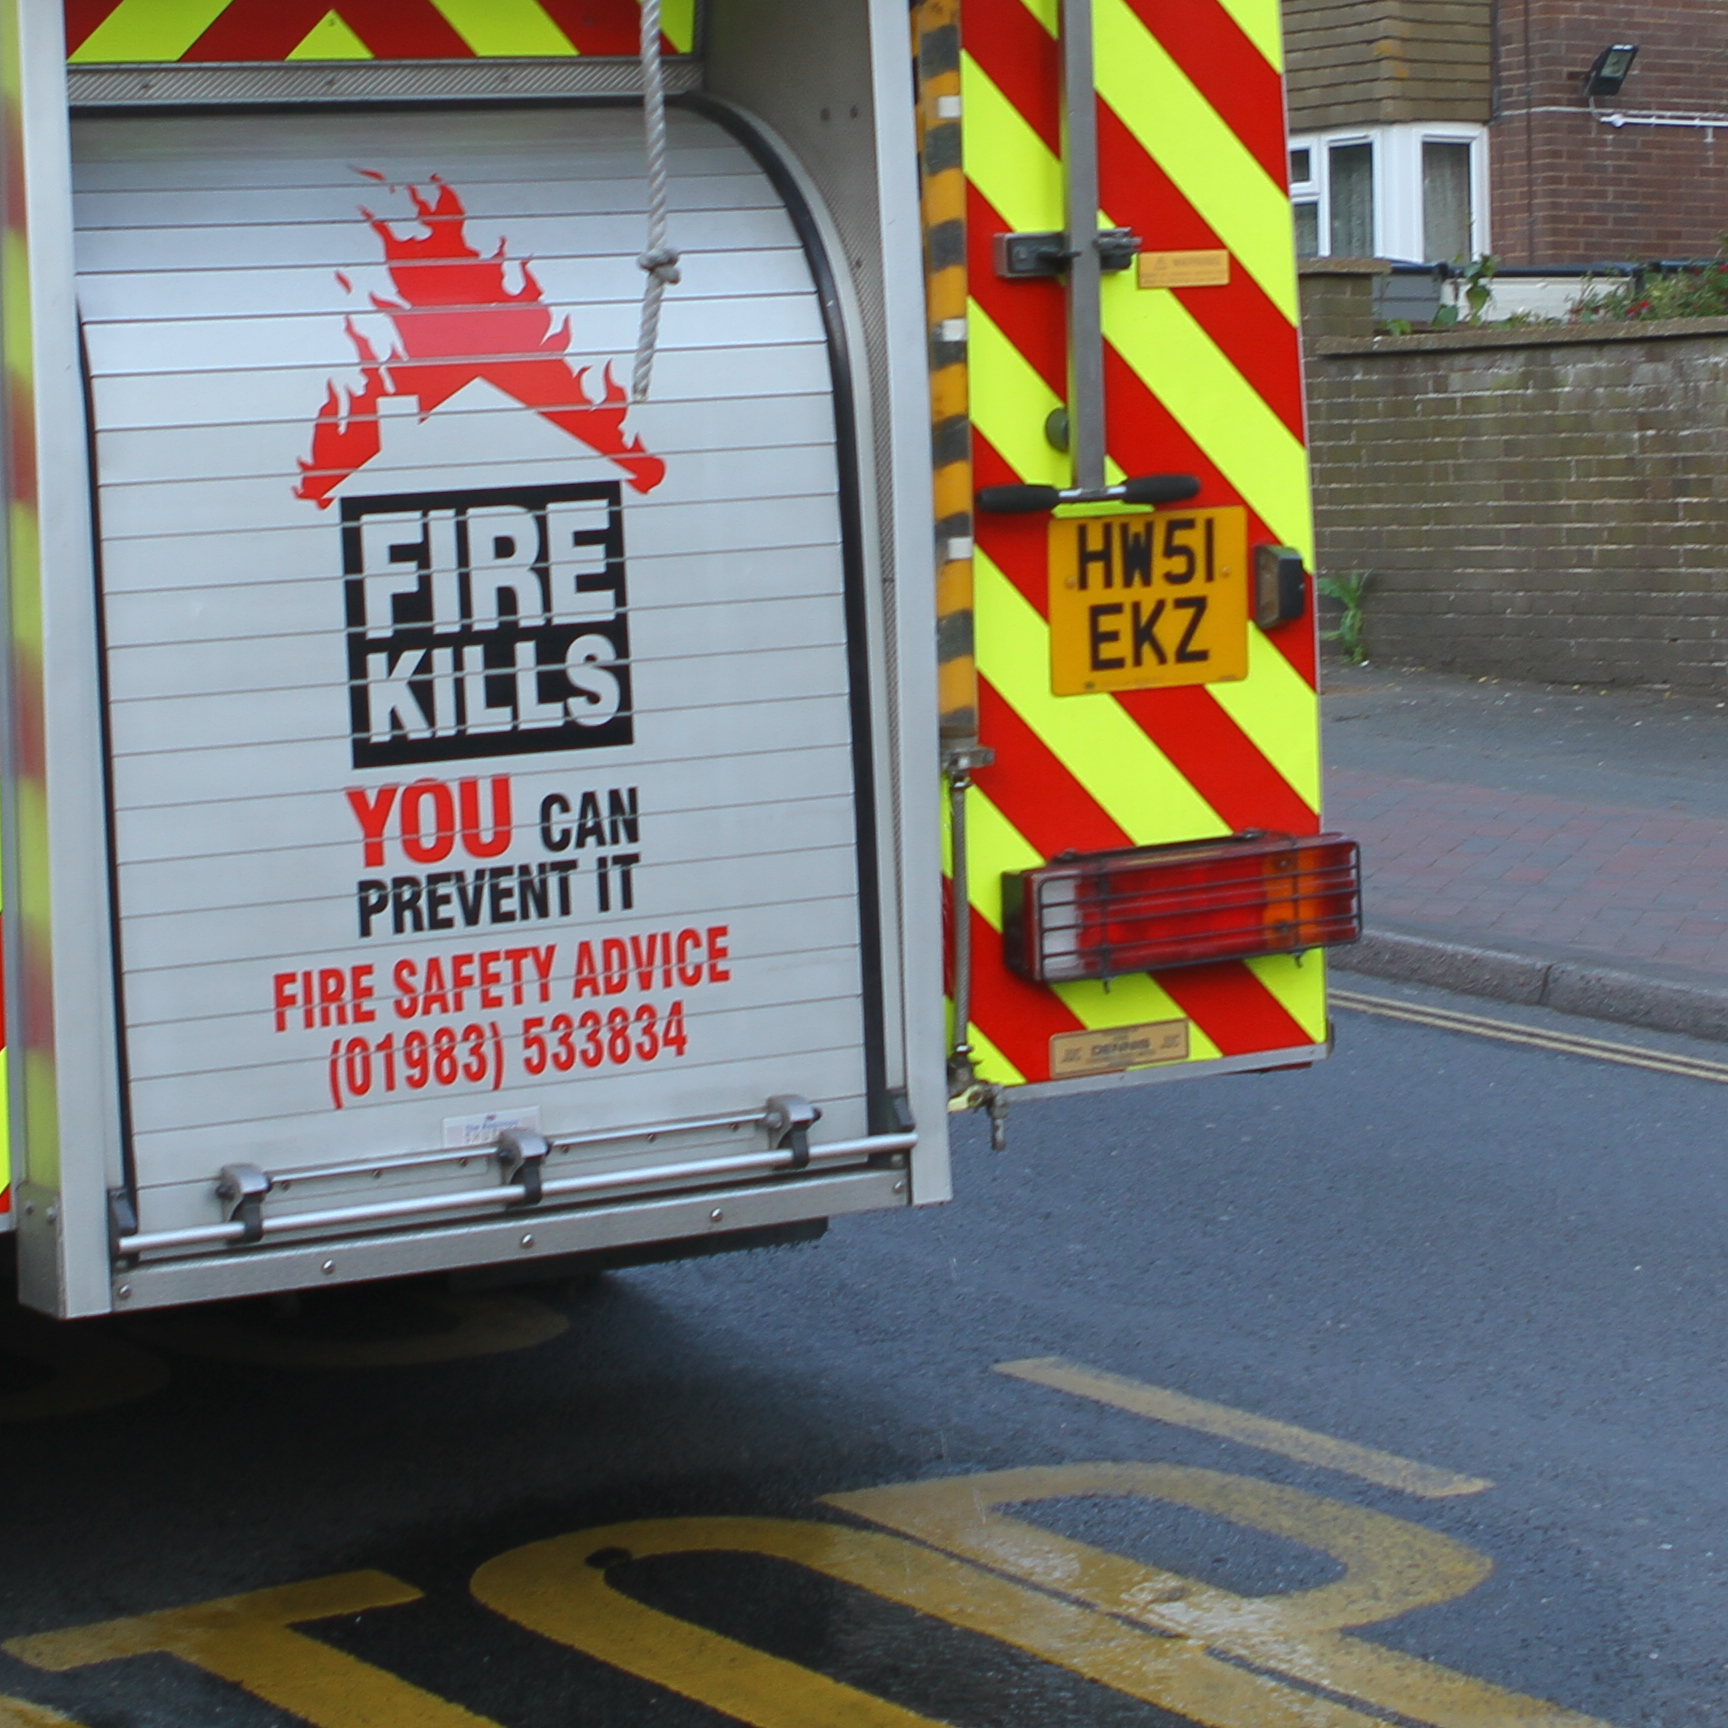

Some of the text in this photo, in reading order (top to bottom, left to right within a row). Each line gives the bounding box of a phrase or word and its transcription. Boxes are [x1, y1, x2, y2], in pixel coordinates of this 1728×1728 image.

[360, 499, 617, 640] FIRE
[1077, 518, 1215, 591] HW51
[1089, 596, 1210, 672] EKZ
[366, 633, 621, 744] KILLS
[345, 775, 640, 869] YOU CAN
[357, 852, 641, 939] PREVENT IT
[273, 925, 731, 1033] FIRE SAFETY ADVICE
[327, 1000, 688, 1110] (01983) 533834
